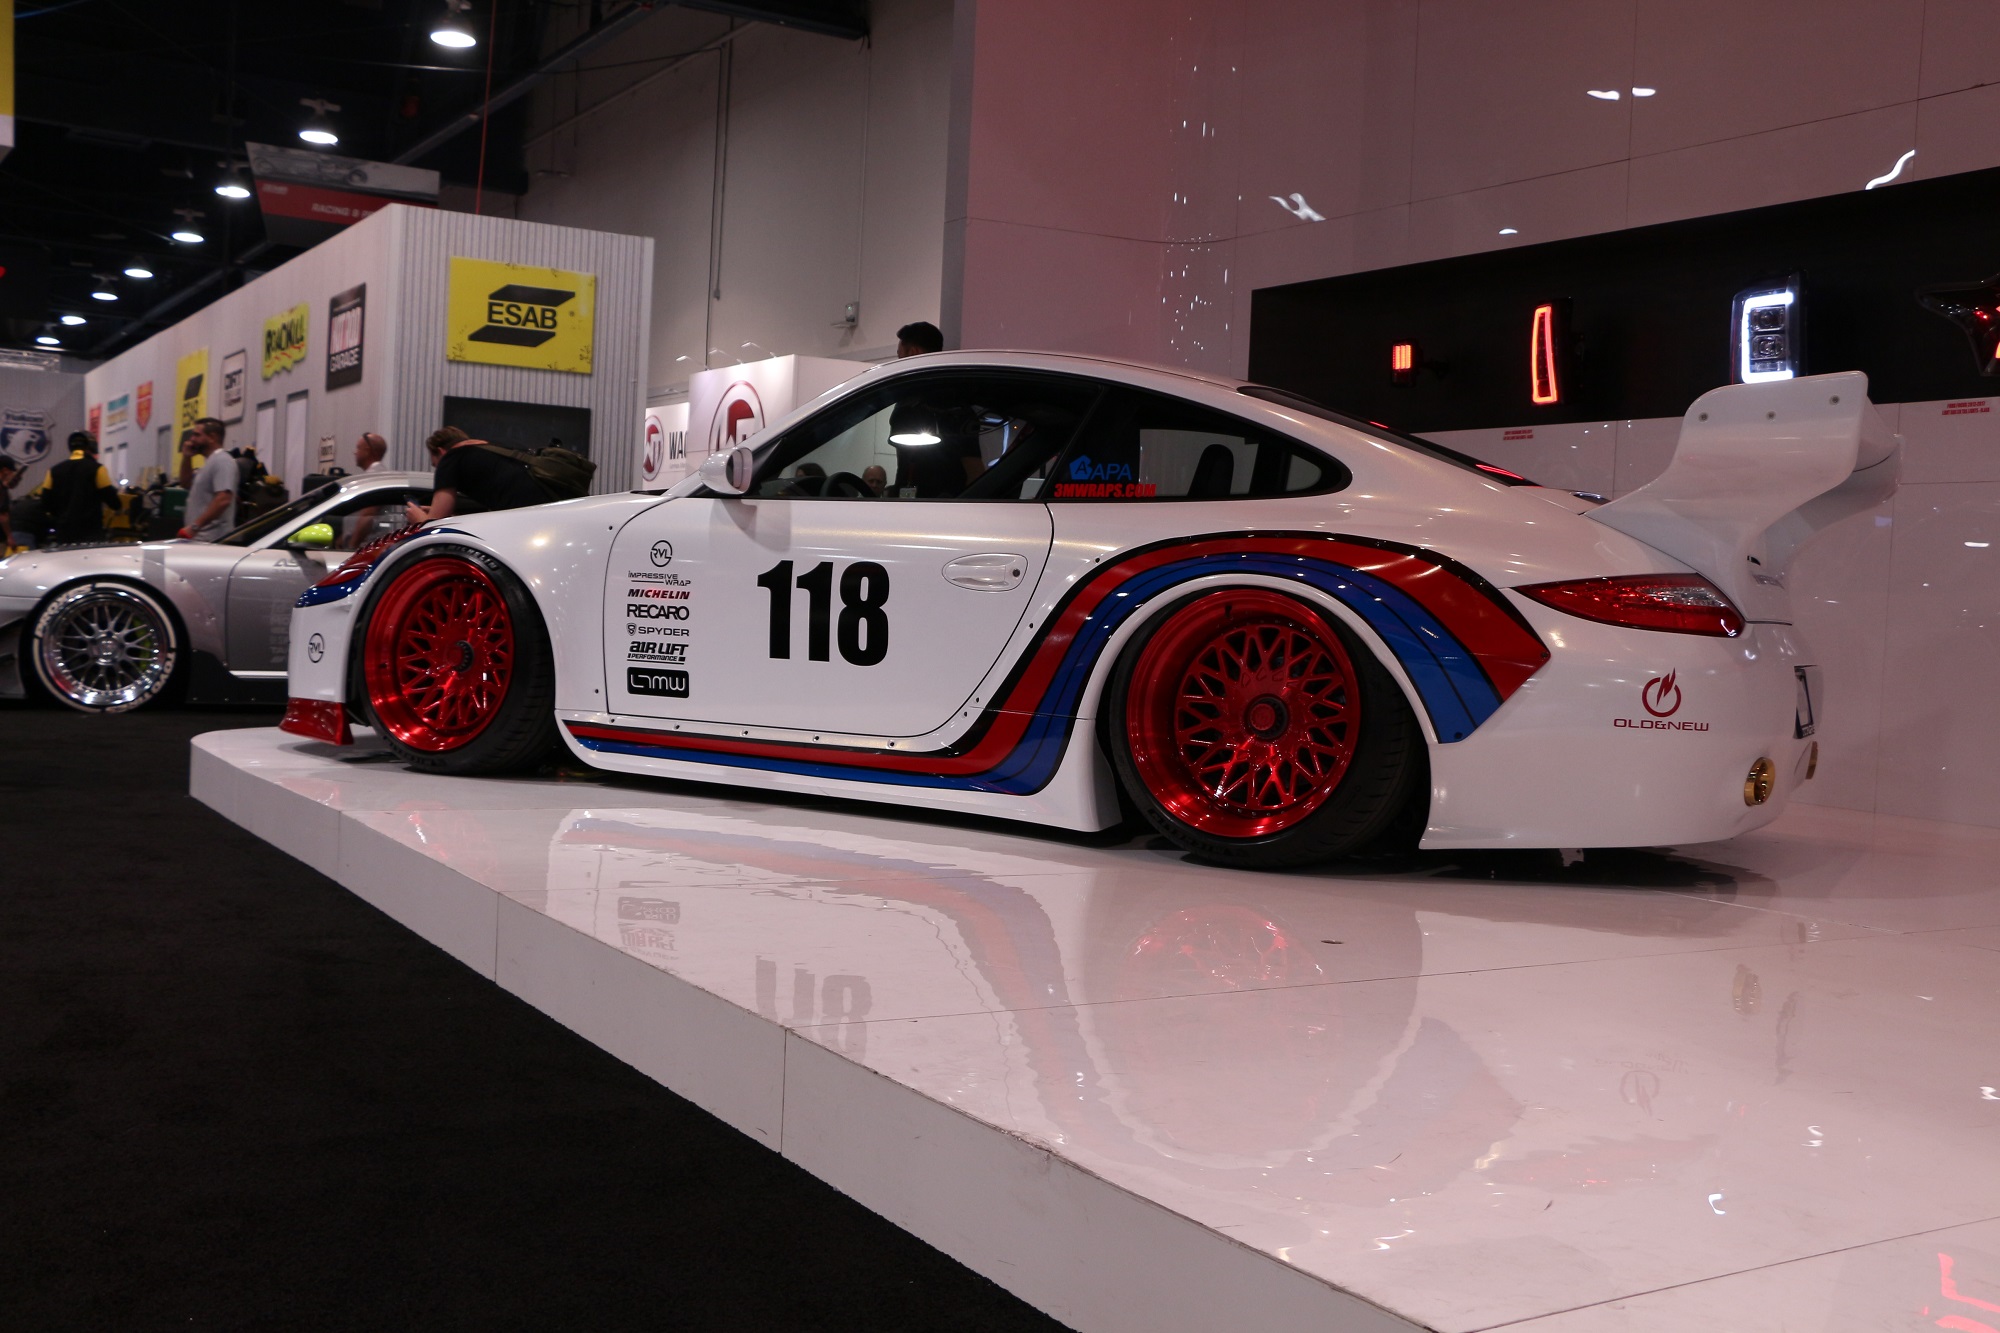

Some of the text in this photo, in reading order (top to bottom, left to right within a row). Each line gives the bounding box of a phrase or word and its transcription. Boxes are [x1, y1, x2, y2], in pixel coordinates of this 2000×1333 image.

[487, 302, 557, 329] ESAB
[330, 347, 360, 373] GARAGE
[1090, 463, 1132, 481] APA
[1054, 483, 1156, 498] 3MWRAPS.COM
[665, 579, 691, 587] WRAP
[627, 588, 691, 600] MICHELIN
[626, 603, 690, 621] RECARO
[757, 559, 890, 666] 118
[638, 626, 690, 637] SPYDER
[658, 643, 689, 656] LIFT
[1613, 718, 1710, 732] OLD&NEW
